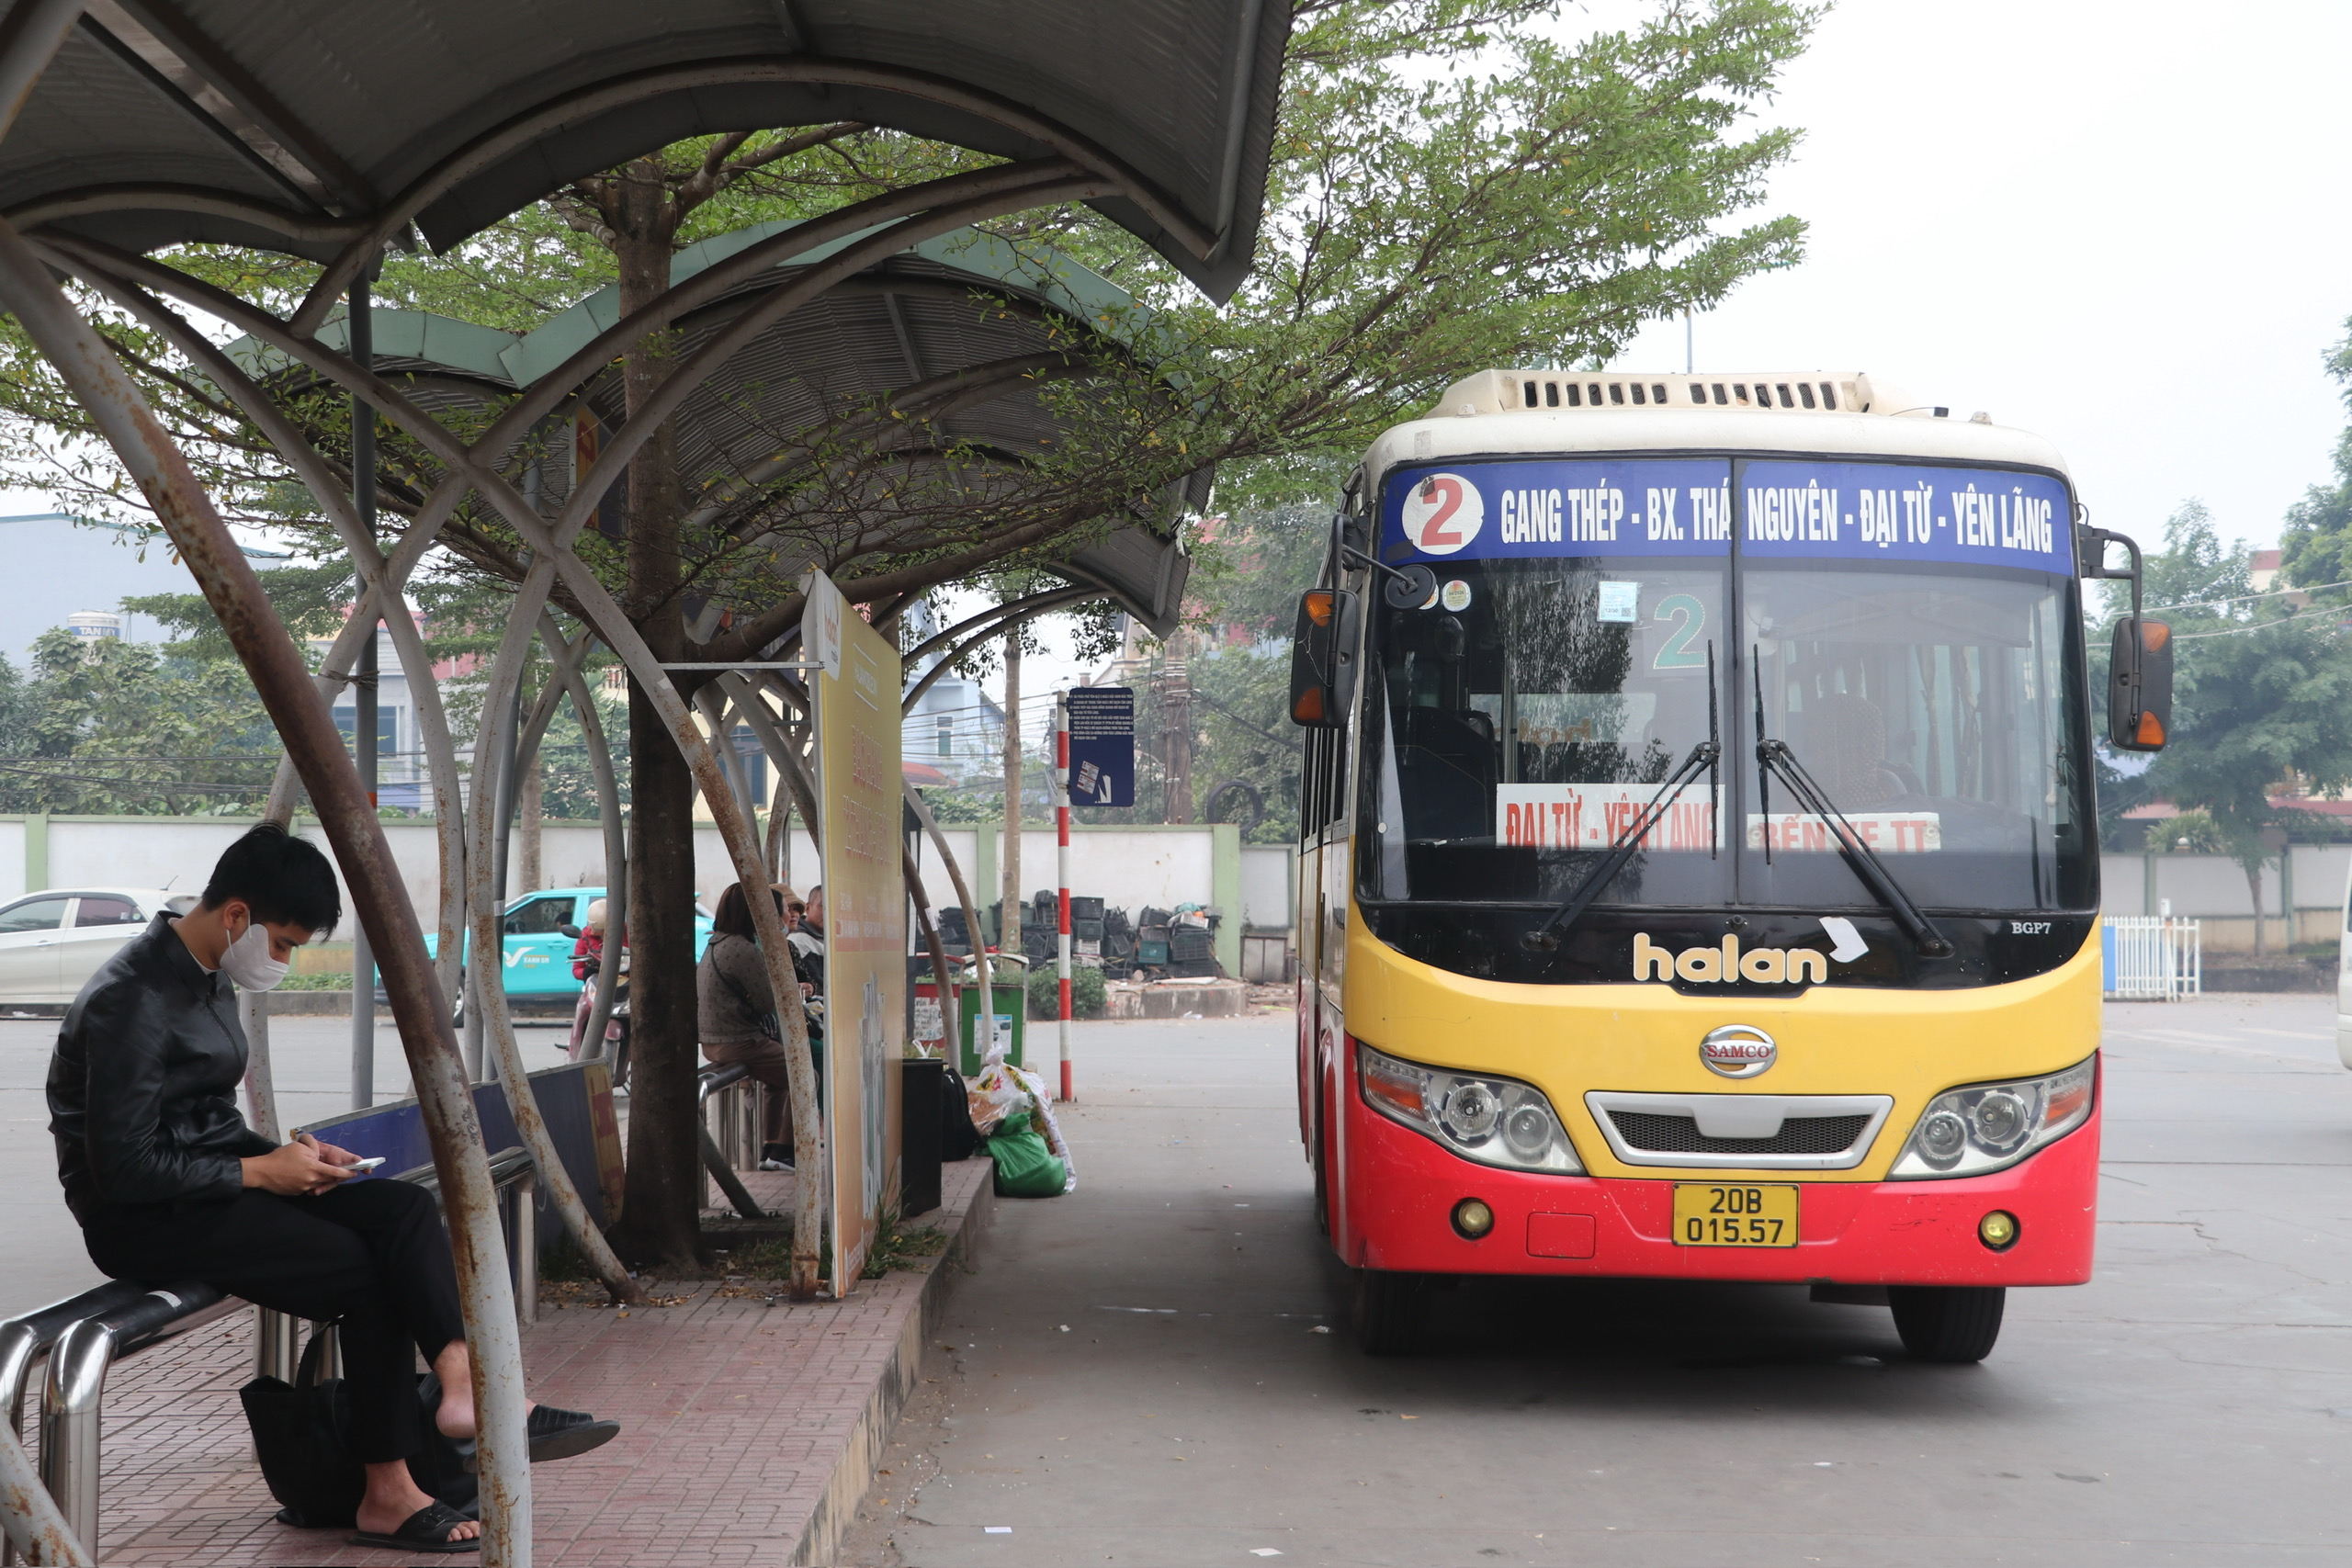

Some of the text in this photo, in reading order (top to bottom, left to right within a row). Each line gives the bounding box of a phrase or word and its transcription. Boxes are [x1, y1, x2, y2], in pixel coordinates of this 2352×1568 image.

[1420, 478, 1464, 547] 2
[1500, 489, 1562, 544] GANG
[1567, 478, 1624, 542] THÉP
[1646, 488, 1683, 541] BX.
[1690, 477, 1733, 541] THÁ
[1747, 479, 1838, 541] NGUYÊN
[1860, 489, 1898, 548] ĐẠI
[1903, 480, 1932, 544] TỪ
[1951, 483, 1995, 547] YÊN
[2000, 486, 2052, 554] LÃNG
[1653, 593, 1707, 670] 2
[1604, 792, 1649, 851] YÊN
[2011, 921, 2052, 935] BGP7
[1633, 931, 1827, 984] halan
[1706, 1044, 1770, 1058] SAMCO
[1710, 1187, 1762, 1214] 20B
[1687, 1217, 1784, 1244] 015.57
